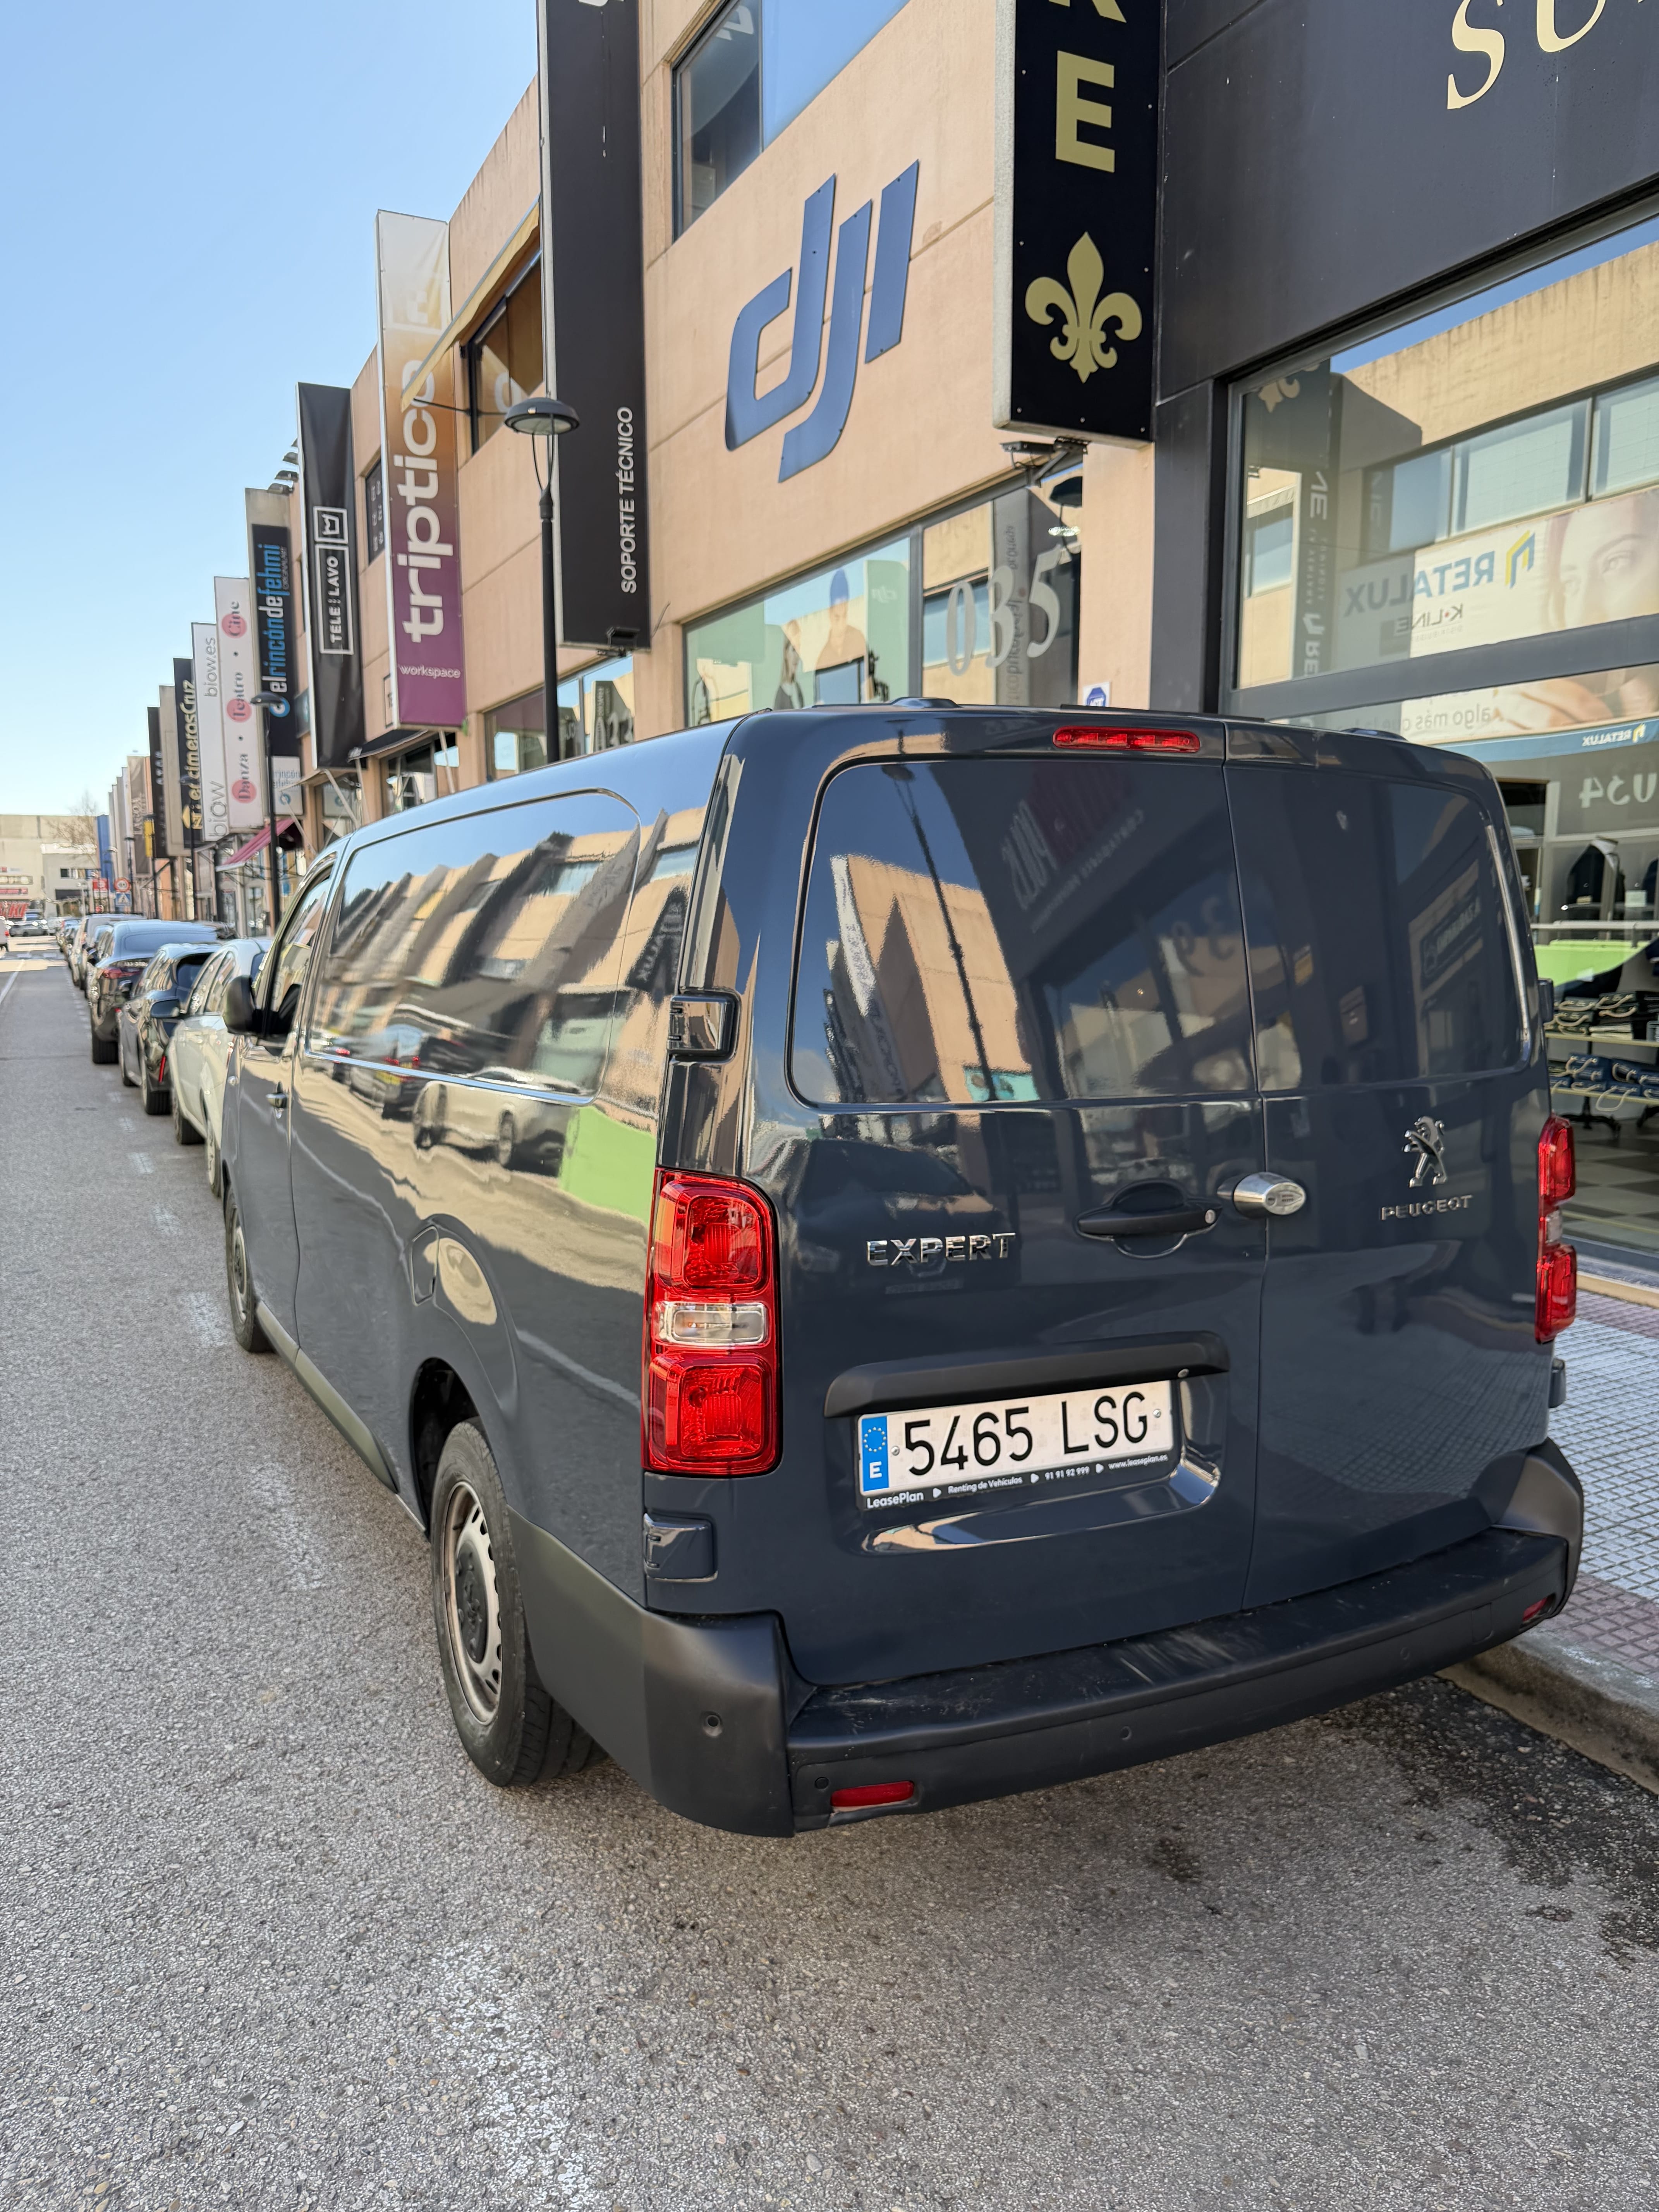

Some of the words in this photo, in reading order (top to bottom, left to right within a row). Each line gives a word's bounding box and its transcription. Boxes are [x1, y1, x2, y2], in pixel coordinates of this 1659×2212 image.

[615, 407, 634, 494] TÉCNICO
[620, 498, 636, 594] SOPORTE
[228, 601, 241, 637] Cine
[946, 544, 1062, 676] 035
[232, 672, 245, 718] Teatro
[400, 664, 460, 678] workspace
[238, 753, 251, 802] Danza
[208, 780, 227, 837] biow
[1381, 1195, 1472, 1220] PEUGEOT
[867, 1232, 1016, 1266] EXPERT
[905, 1406, 1033, 1475] 5465
[1062, 1392, 1148, 1455] LSG
[867, 1491, 924, 1508] LeasePlan
[948, 1484, 977, 1495] Renting
[978, 1481, 988, 1490] de
[1045, 1472, 1054, 1480] 91
[1055, 1470, 1064, 1479] 91
[1066, 1468, 1075, 1477] 92
[1076, 1467, 1089, 1475] 999
[1108, 1454, 1168, 1470] www.leaseplan.es
[870, 1462, 882, 1478] E
